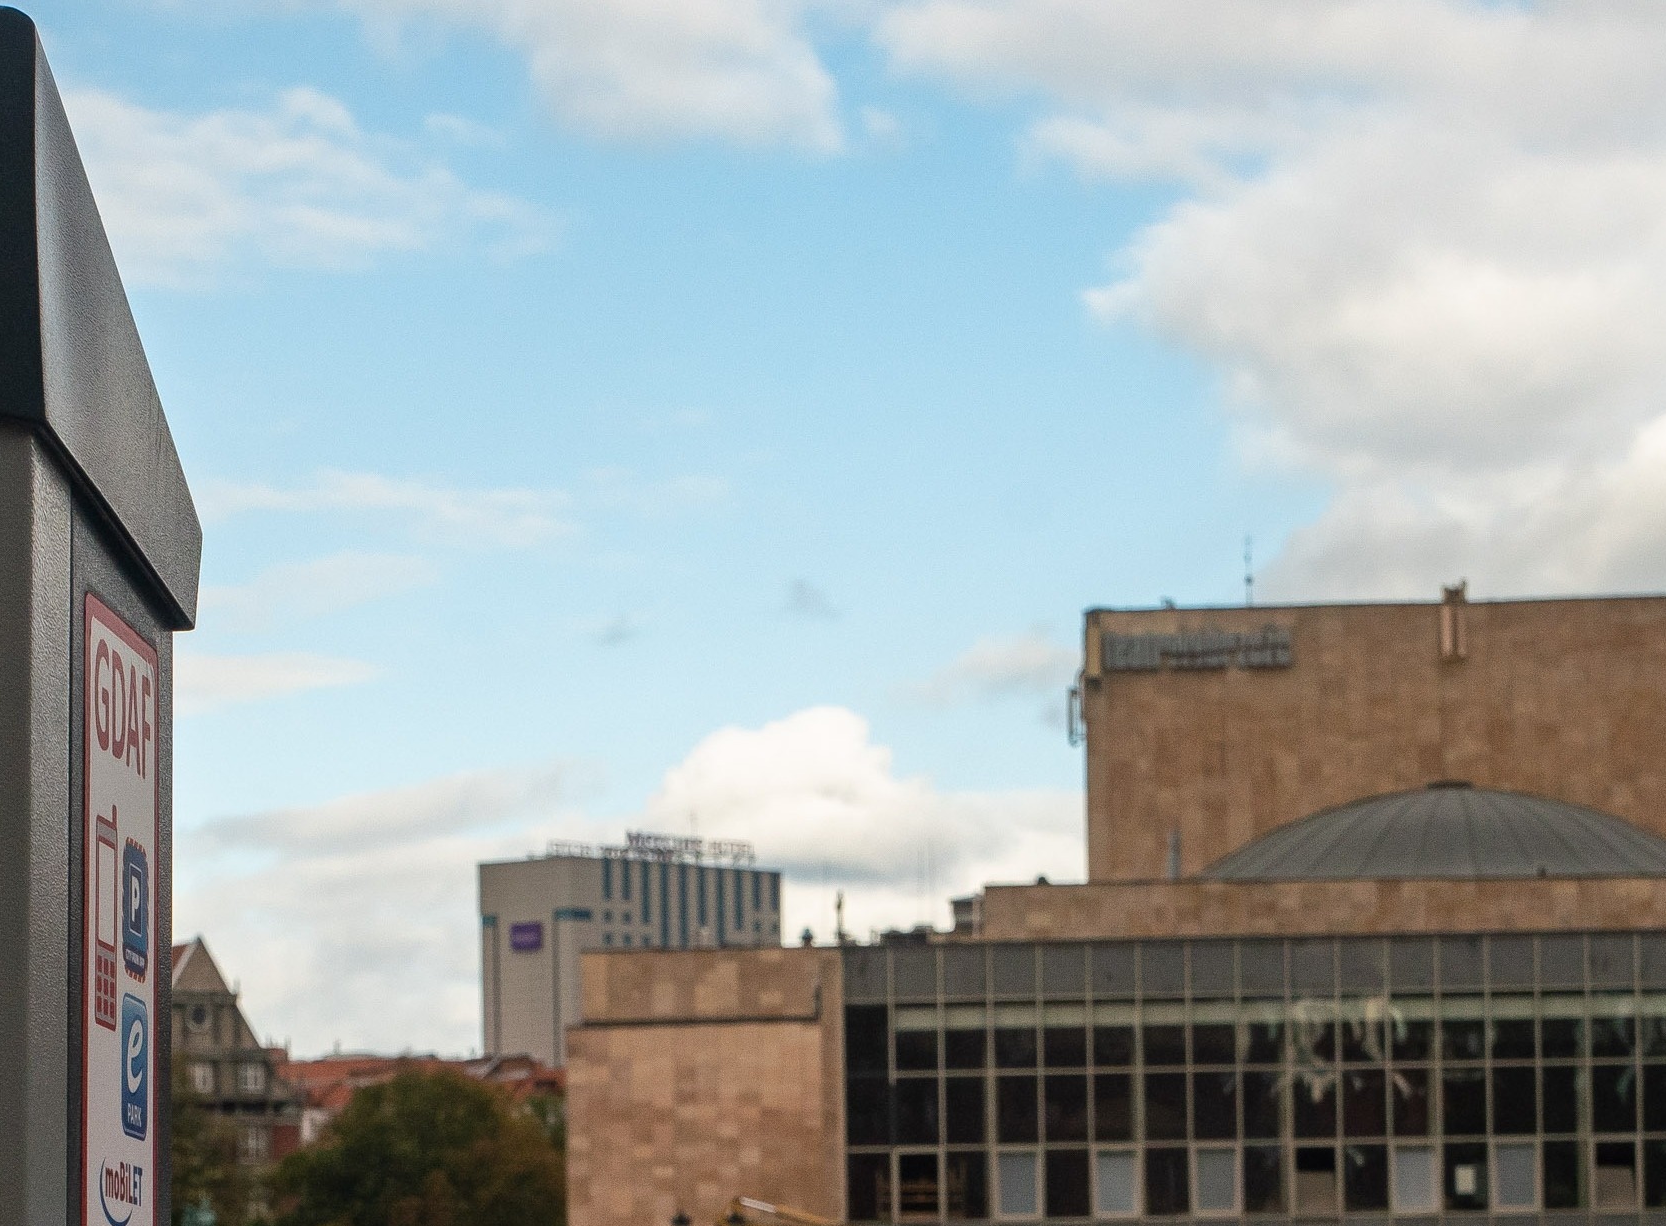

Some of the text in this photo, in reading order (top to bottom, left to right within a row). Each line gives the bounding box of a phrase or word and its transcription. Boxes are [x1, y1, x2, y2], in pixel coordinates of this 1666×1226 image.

[95, 639, 150, 779] GDAF
[132, 875, 140, 922] P
[128, 1103, 142, 1127] PARK
